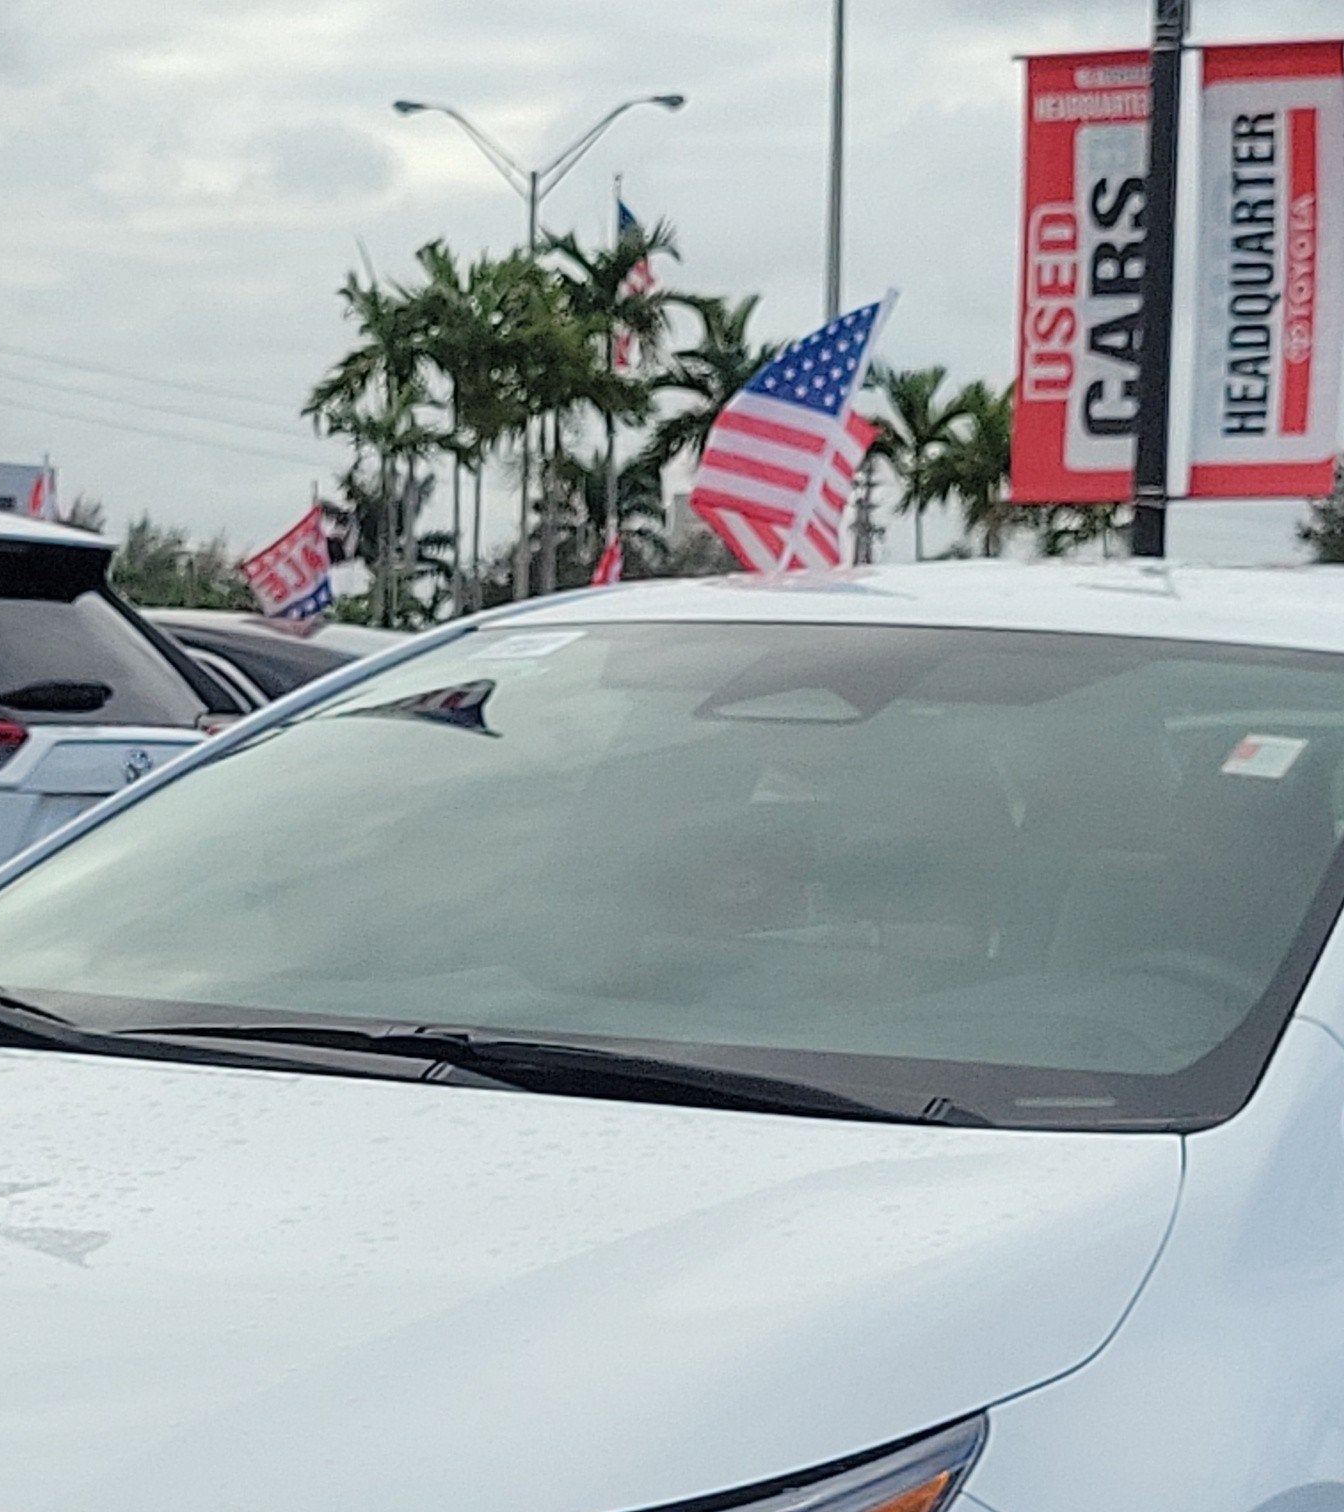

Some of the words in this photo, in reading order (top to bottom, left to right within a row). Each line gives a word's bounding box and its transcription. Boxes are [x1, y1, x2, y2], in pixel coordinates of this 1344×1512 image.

[1030, 211, 1078, 392] USED
[1083, 175, 1149, 437] CARS
[1222, 111, 1278, 438] HEADQUARTER
